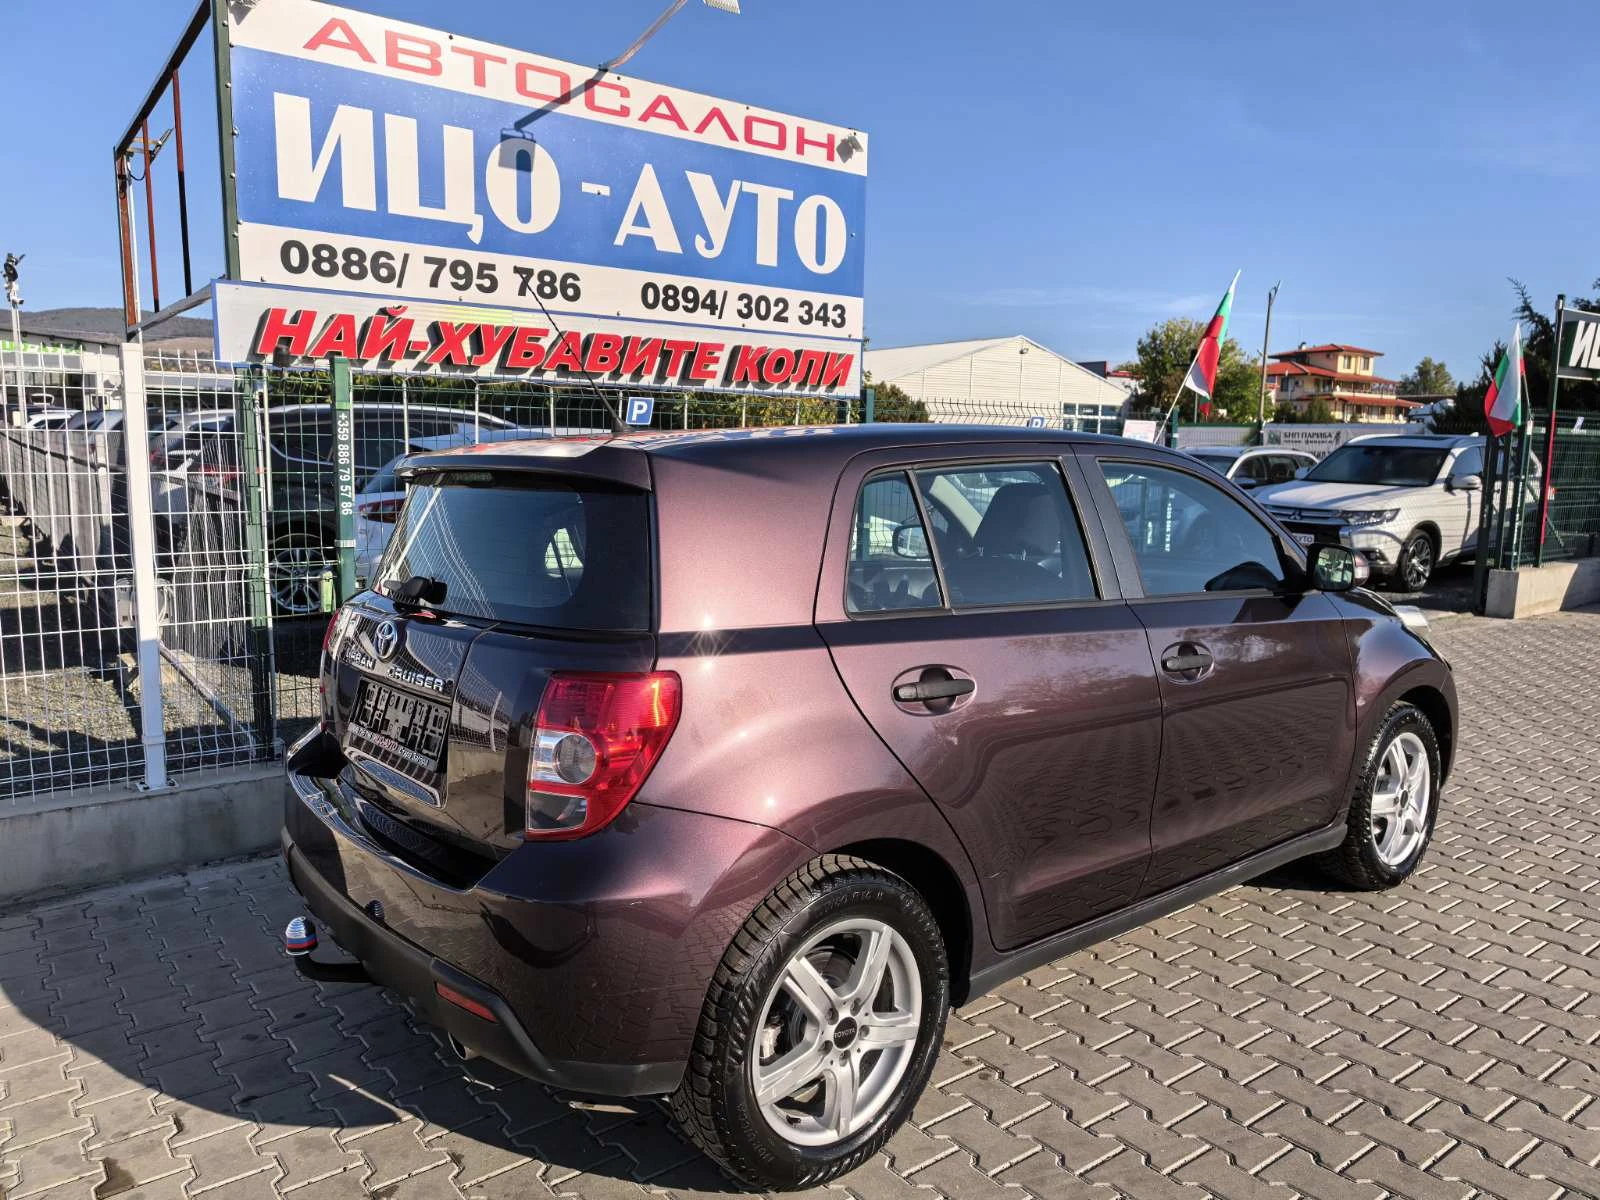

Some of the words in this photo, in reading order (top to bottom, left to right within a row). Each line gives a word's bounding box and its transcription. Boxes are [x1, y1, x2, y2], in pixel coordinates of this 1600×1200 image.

[303, 17, 836, 162] АВТОСАЛОН
[273, 92, 561, 245] ИЦО
[280, 239, 410, 289] 0886/
[423, 256, 499, 295] 795
[513, 265, 582, 302] 786
[641, 281, 728, 320] 0894/
[736, 293, 789, 323] 302
[799, 300, 847, 329] 343
[255, 304, 726, 383] НАЙ-ХУБАВИТЕ
[732, 345, 855, 388] КОЛИ
[631, 400, 648, 421] P
[337, 412, 349, 441] +359
[338, 444, 350, 465] 886
[338, 468, 350, 482] 79
[340, 485, 352, 498] 57
[341, 501, 353, 516] 86
[387, 666, 444, 692] CRUISER
